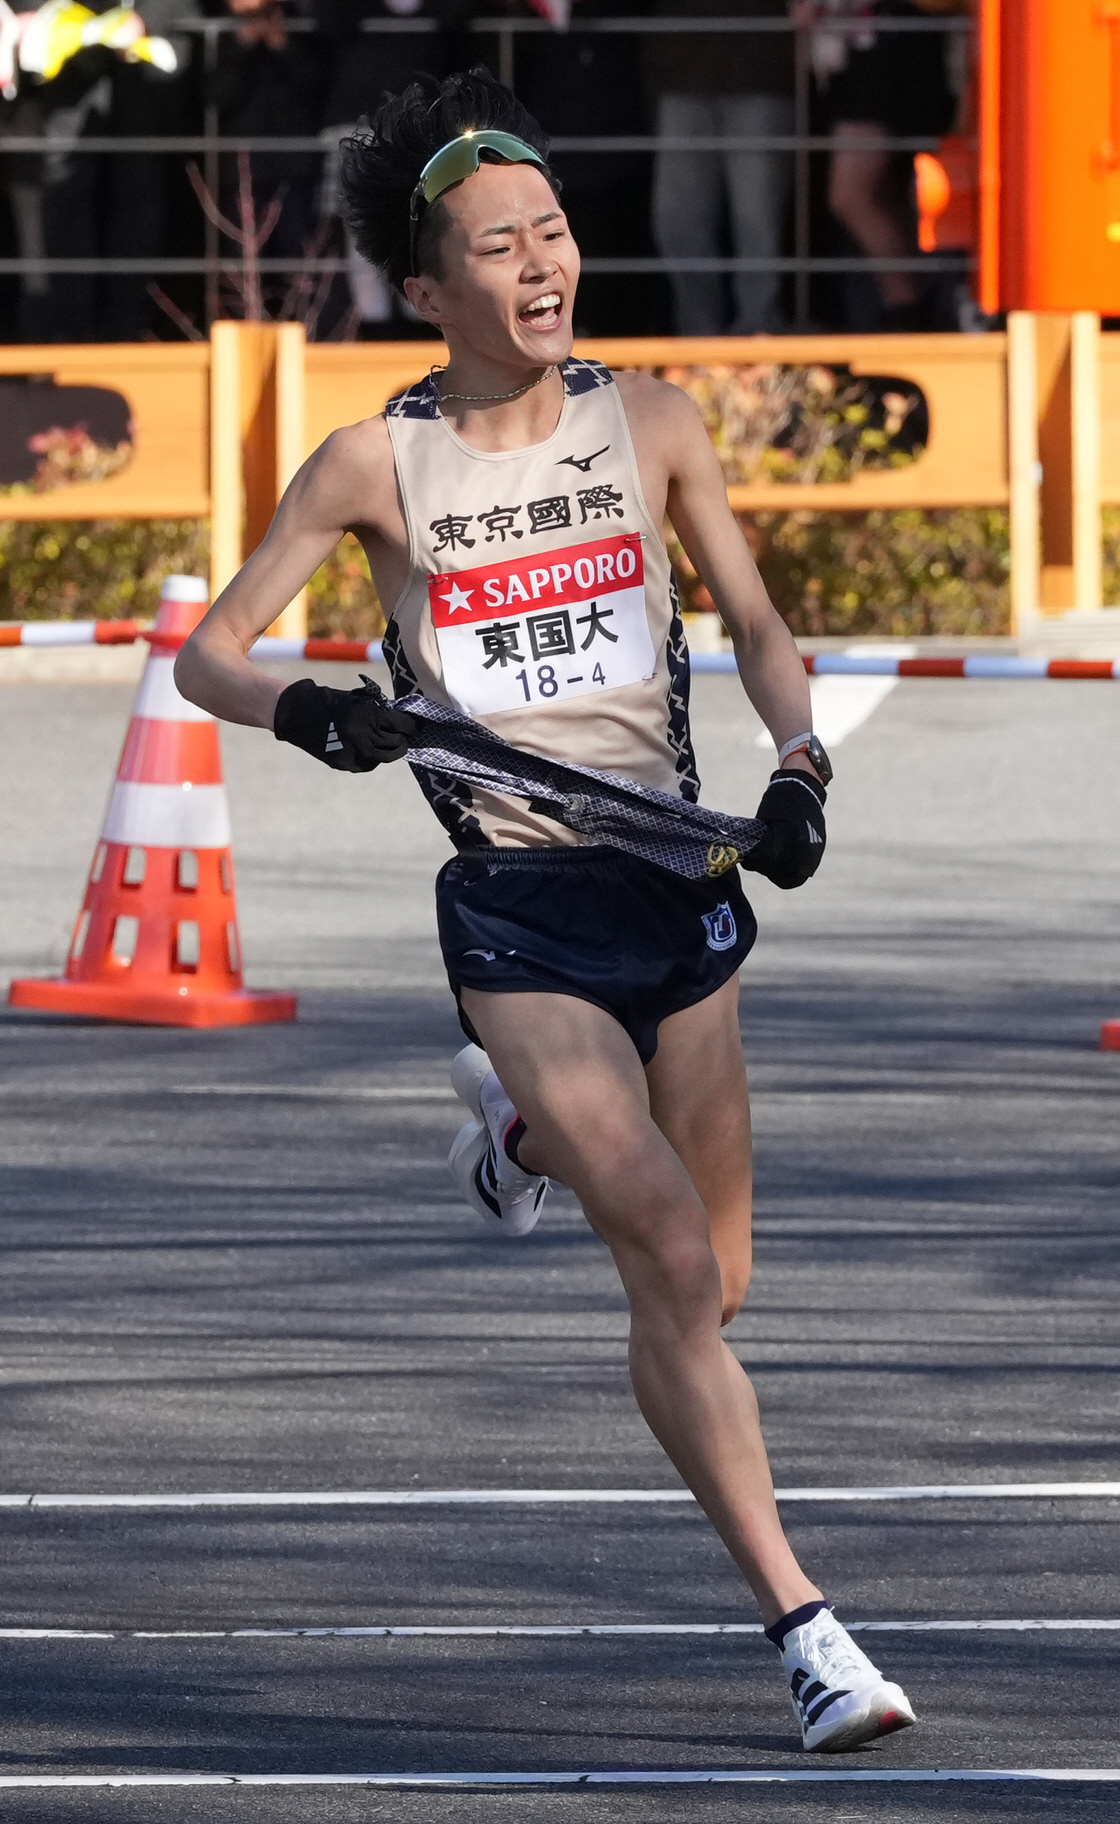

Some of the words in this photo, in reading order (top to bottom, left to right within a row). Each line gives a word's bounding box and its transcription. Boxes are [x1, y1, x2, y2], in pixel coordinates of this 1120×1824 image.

[429, 483, 625, 553] 東京國際
[482, 548, 637, 608] SAPPORO
[475, 601, 619, 670] 東国大
[515, 661, 606, 702] 18-4
